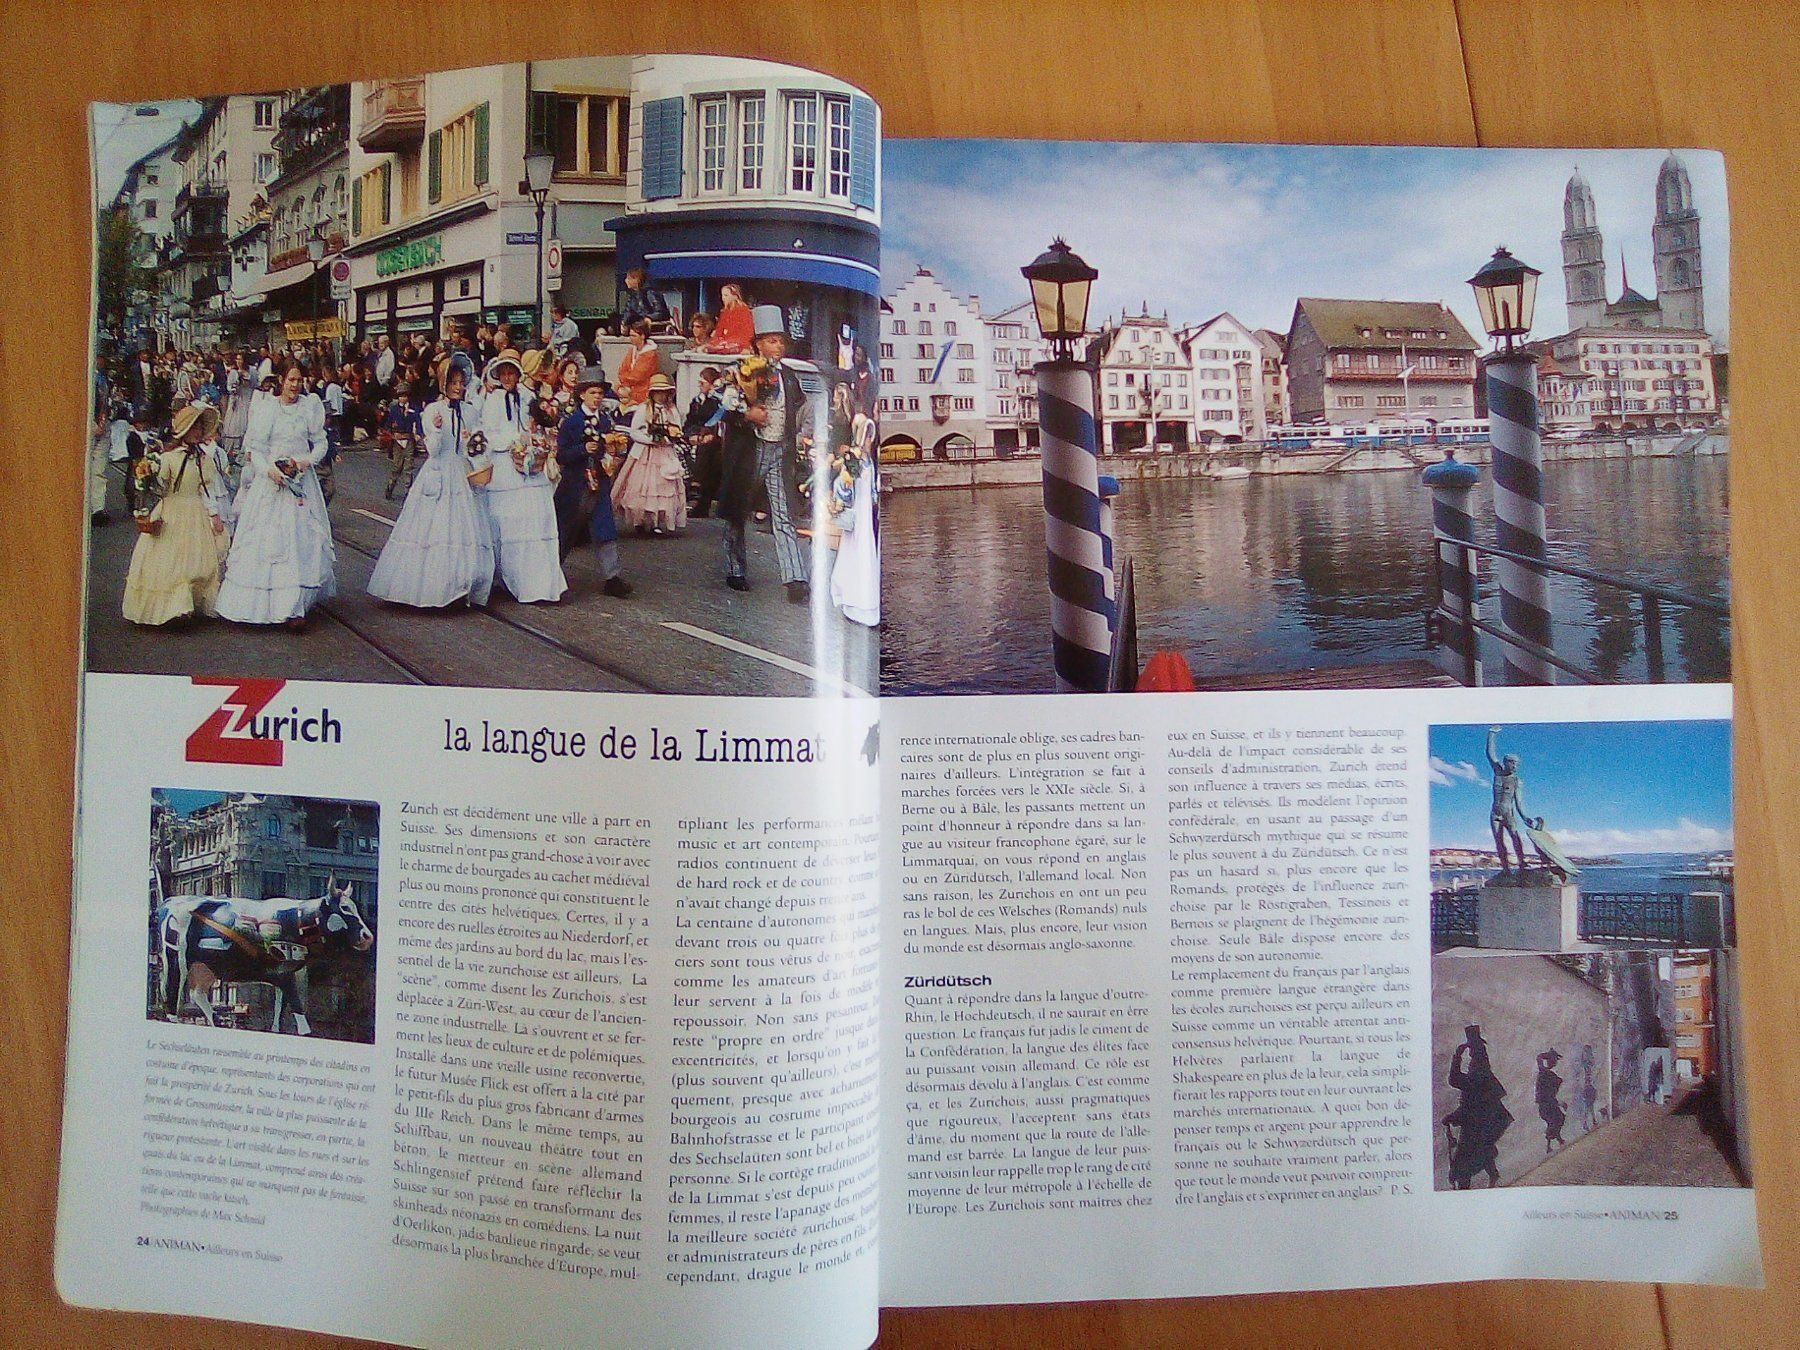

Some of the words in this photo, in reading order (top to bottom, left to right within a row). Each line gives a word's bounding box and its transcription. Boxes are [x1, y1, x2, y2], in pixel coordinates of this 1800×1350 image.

[444, 718, 471, 752] la
[482, 720, 586, 763] langue
[600, 726, 637, 760] de
[650, 727, 681, 761] la
[695, 728, 826, 763] Limmat
[900, 737, 932, 745] rence
[934, 732, 1017, 745] internationale
[1060, 735, 1078, 743] ses
[1079, 731, 1117, 743] cadres
[400, 802, 438, 816] Zurich
[442, 807, 458, 817] est
[534, 814, 557, 822] une
[561, 811, 587, 824] ville
[604, 816, 631, 830] part
[635, 819, 651, 828] en
[902, 802, 935, 814] Berne
[939, 806, 956, 814] ou
[1004, 801, 1020, 813] les
[1025, 802, 1075, 816] passants
[1079, 801, 1124, 811] mettent
[1129, 803, 1145, 811] un
[677, 818, 727, 833] tipliant
[736, 818, 755, 830] les
[399, 840, 454, 855] industriel
[489, 849, 509, 862] pas
[595, 855, 622, 865] voir
[623, 858, 650, 867] avec
[677, 857, 719, 869] radios
[724, 858, 796, 868] continuent
[802, 856, 816, 867] de
[675, 877, 692, 888] de
[696, 877, 727, 888] hard
[732, 877, 762, 888] rock
[765, 879, 778, 888] et
[781, 877, 797, 888] de
[903, 893, 928, 901] sans
[978, 888, 994, 899] les
[998, 887, 1055, 899] Zurichois
[1059, 890, 1074, 898] en
[1078, 888, 1099, 897] ont
[1104, 889, 1120, 897] un
[1125, 888, 1147, 900] peu
[397, 898, 433, 910] centre
[437, 899, 456, 912] des
[774, 895, 816, 910] depuis
[903, 942, 919, 953] du
[922, 941, 964, 953] monde
[966, 942, 983, 952] est
[673, 978, 724, 987] comme
[732, 974, 749, 985] les
[757, 974, 815, 985] amateurs
[904, 974, 992, 988] Züridütsch
[673, 995, 700, 1007] leur
[708, 995, 755, 1005] servent
[800, 990, 821, 1002] fois
[904, 993, 942, 1005] Quant
[1014, 991, 1042, 1003] dans
[1045, 991, 1057, 1002] la
[1059, 990, 1099, 1005] langue
[395, 1030, 424, 1042] ment
[427, 1032, 443, 1044] les
[445, 1033, 472, 1047] lieux
[475, 1036, 490, 1049] de
[492, 1038, 534, 1053] culture
[536, 1044, 549, 1055] et
[550, 1044, 566, 1056] de
[1106, 1078, 1150, 1088] comme
[670, 1129, 772, 1145] Bahnhofstrasse
[458, 1133, 474, 1142] un
[481, 1136, 532, 1149] nouveau
[591, 1147, 619, 1159] tout
[627, 1153, 643, 1162] en
[1664, 1211, 1679, 1221] 25
[136, 1236, 150, 1246] 24
[667, 1231, 679, 1243] la
[685, 1228, 748, 1242] meilleure
[464, 1243, 489, 1261] plus
[666, 1252, 679, 1262] et
[682, 1245, 789, 1261] administrateurs
